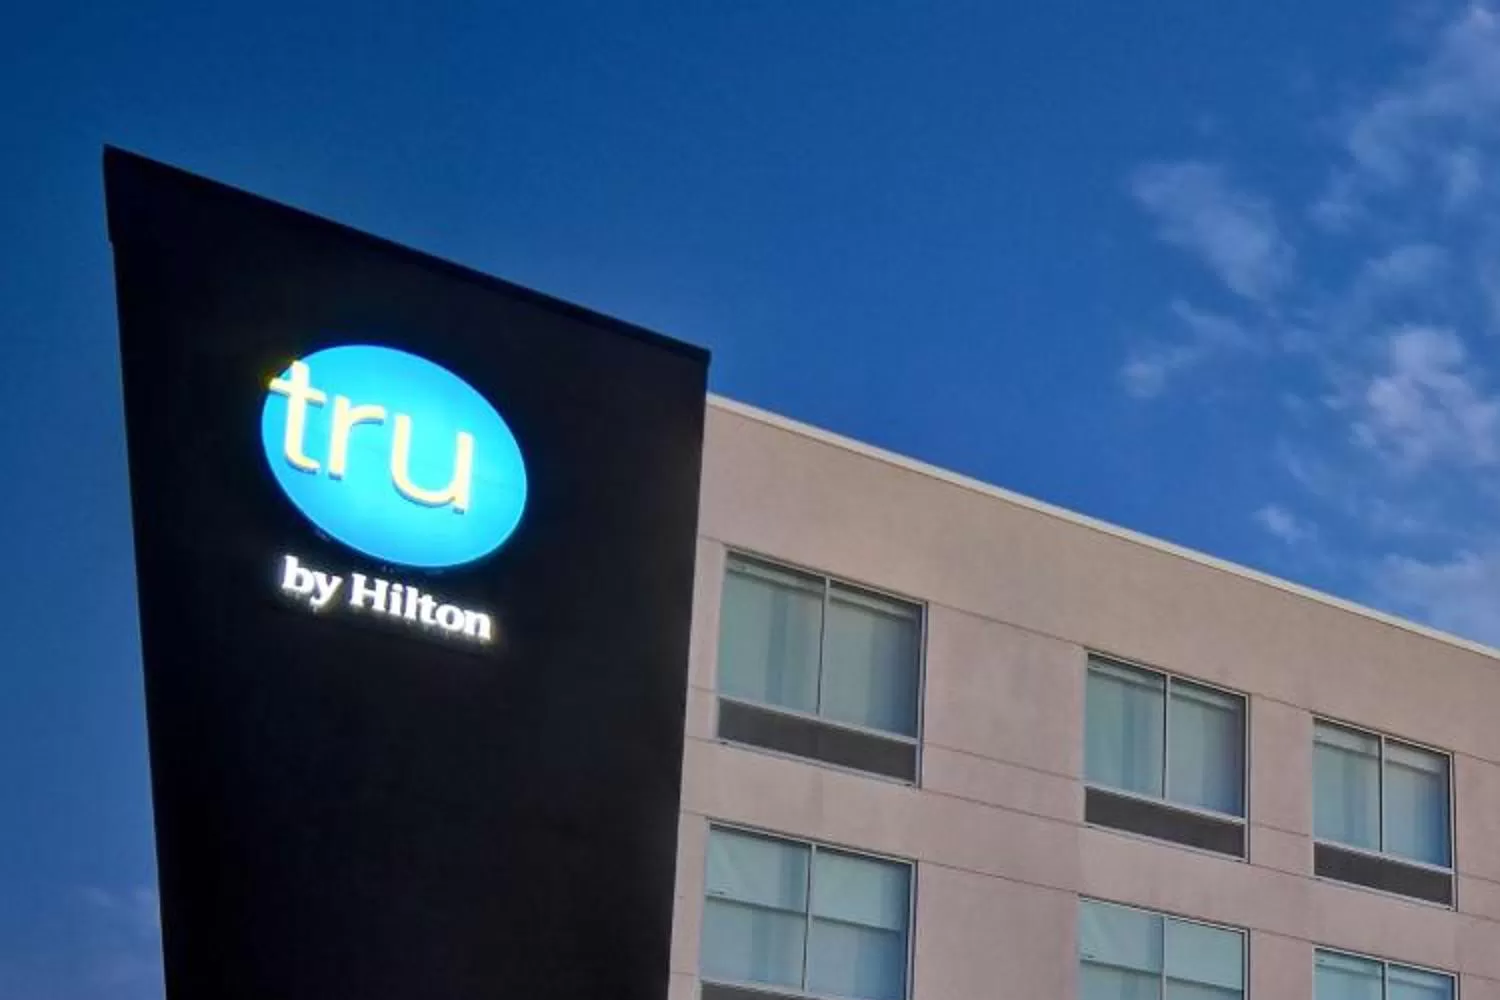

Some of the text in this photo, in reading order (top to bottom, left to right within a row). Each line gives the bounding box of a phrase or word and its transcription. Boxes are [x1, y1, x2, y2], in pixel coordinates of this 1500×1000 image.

[269, 360, 475, 514] tru
[281, 554, 492, 640] by Hilton
